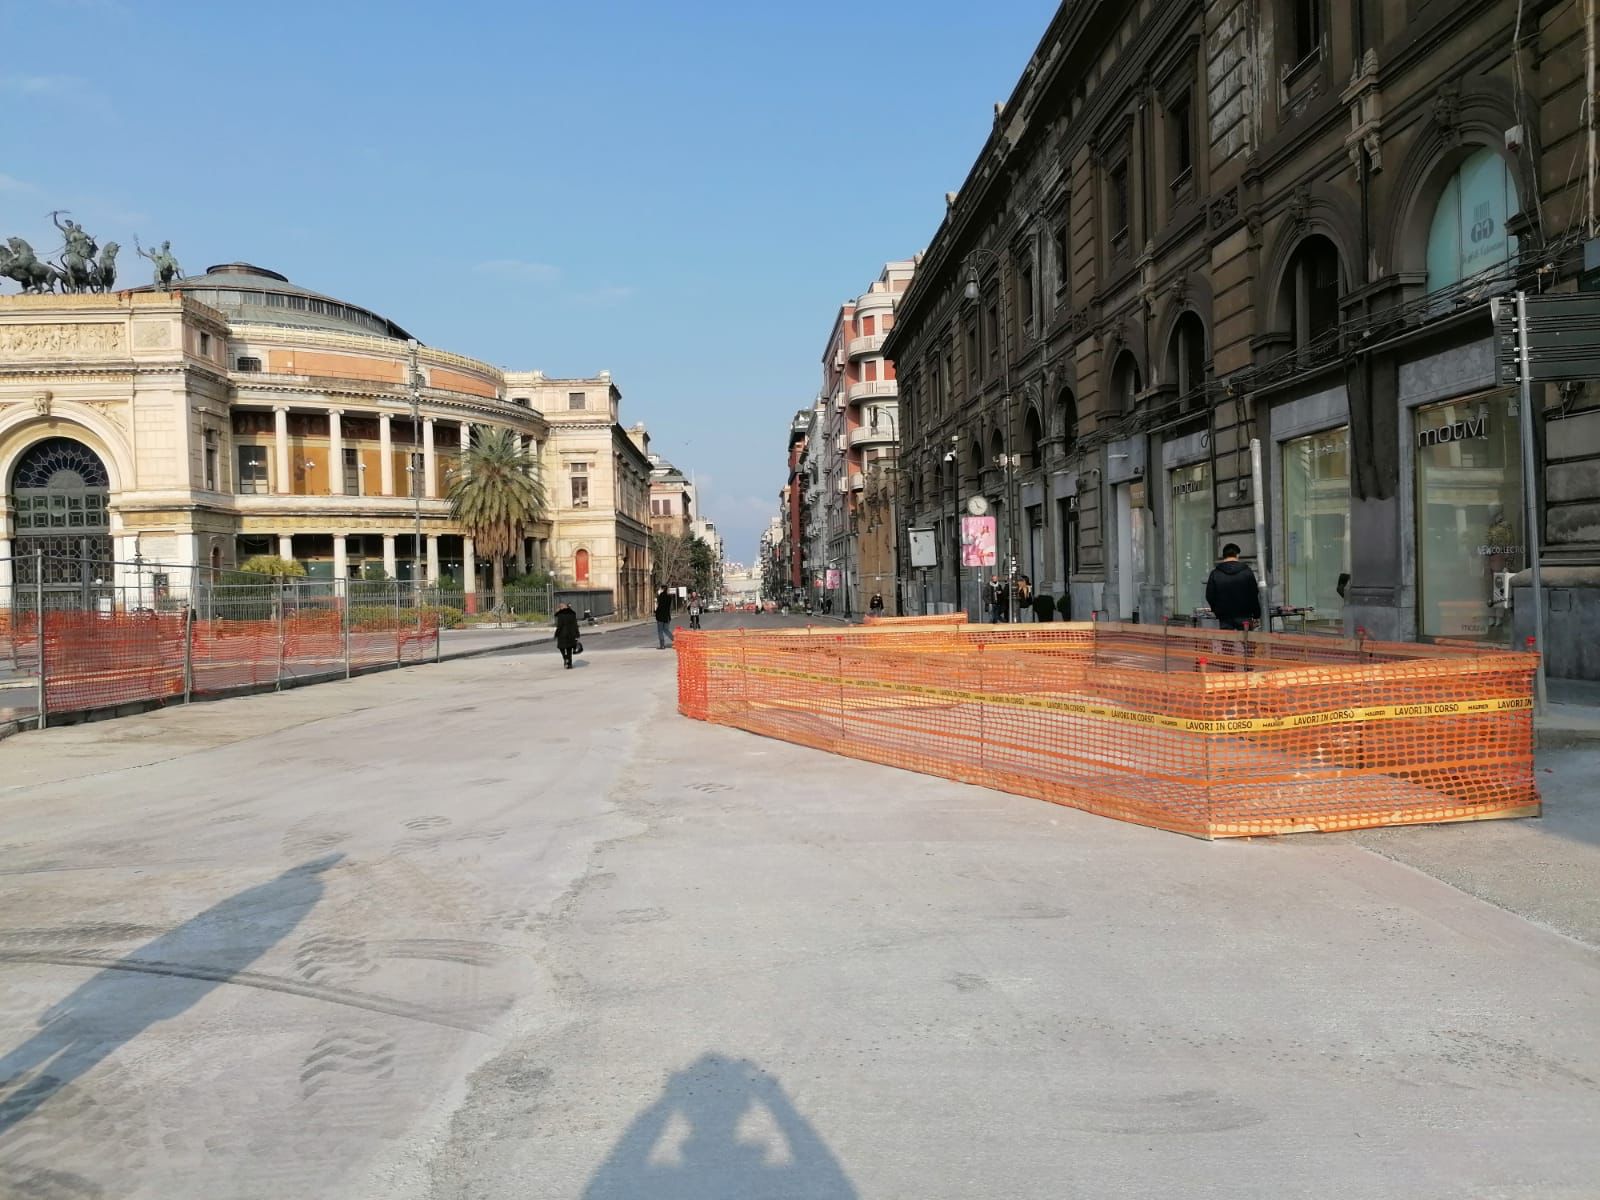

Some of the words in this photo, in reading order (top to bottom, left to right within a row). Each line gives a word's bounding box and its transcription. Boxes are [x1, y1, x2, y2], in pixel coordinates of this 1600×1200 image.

[1070, 704, 1086, 713] CORSO
[1111, 709, 1129, 720] LAVORI
[1129, 712, 1137, 722] IN
[1137, 713, 1155, 724] CORSO
[1186, 721, 1213, 731] LAVORI
[1216, 722, 1225, 730] IN
[1227, 720, 1252, 730] CORSO
[1293, 714, 1320, 726] LAVORI
[1321, 713, 1329, 722] IN
[1329, 710, 1355, 721] CORSO
[1394, 705, 1423, 716] LAVORI
[1424, 705, 1433, 714] IN
[1434, 703, 1459, 713] CORSO
[1497, 699, 1523, 709] LAVORI
[1523, 698, 1532, 707] IN
